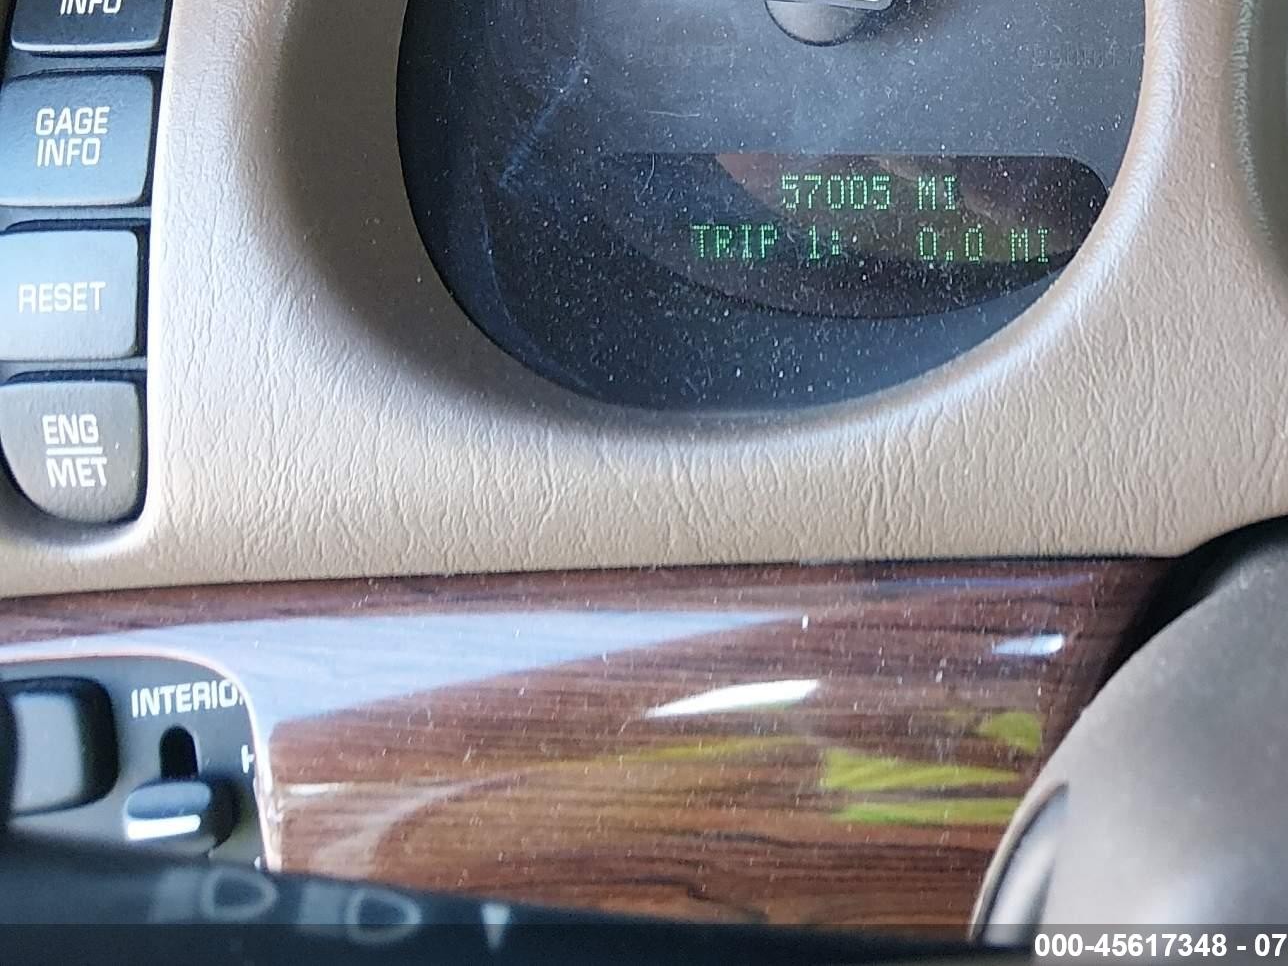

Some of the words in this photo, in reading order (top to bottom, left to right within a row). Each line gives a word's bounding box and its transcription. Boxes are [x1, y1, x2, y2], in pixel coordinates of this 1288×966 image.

[35, 106, 110, 135] GAGE
[36, 138, 101, 167] INFO
[781, 174, 890, 210] 57005
[918, 175, 956, 210] MI
[691, 224, 778, 259] TRIP
[808, 225, 841, 260] 1:
[919, 227, 983, 262] 0.0
[1011, 228, 1048, 263] MI
[18, 280, 107, 314] RESET
[42, 413, 99, 446] ENG
[45, 456, 108, 489] MET
[131, 680, 246, 718] INTERIO
